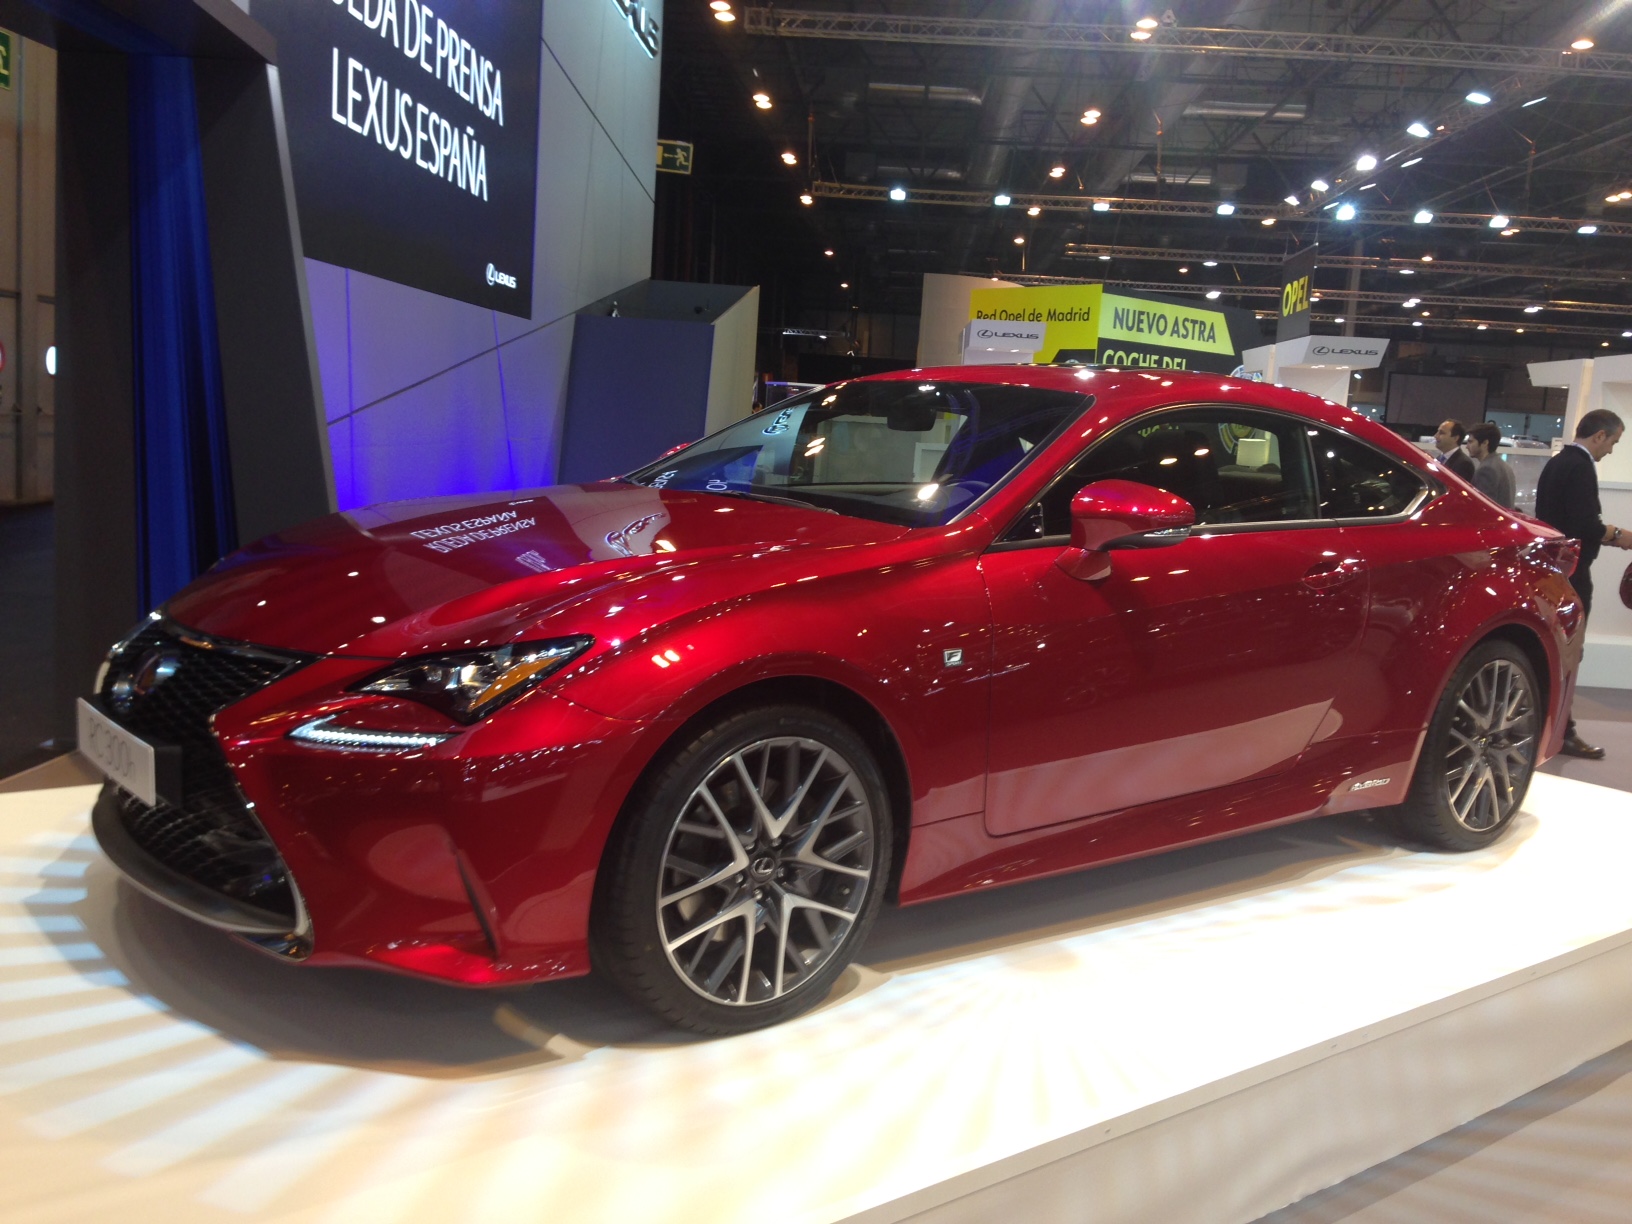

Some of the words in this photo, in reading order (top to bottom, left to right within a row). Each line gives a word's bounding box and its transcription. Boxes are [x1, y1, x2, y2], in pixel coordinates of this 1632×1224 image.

[404, 0, 433, 73] DE
[436, 18, 503, 126] PRENSA
[332, 47, 412, 159] LEXUS
[416, 102, 488, 201] ESPAÑA
[976, 309, 996, 320] Red
[1000, 308, 1025, 321] Opel
[1028, 308, 1042, 322] de
[1046, 307, 1090, 322] Madrid
[1282, 275, 1309, 317] OPEL
[994, 331, 1039, 340] LEXUS
[1113, 306, 1168, 336] NUEVO
[1170, 316, 1216, 343] ASTRA
[1331, 347, 1379, 356] LEXUS
